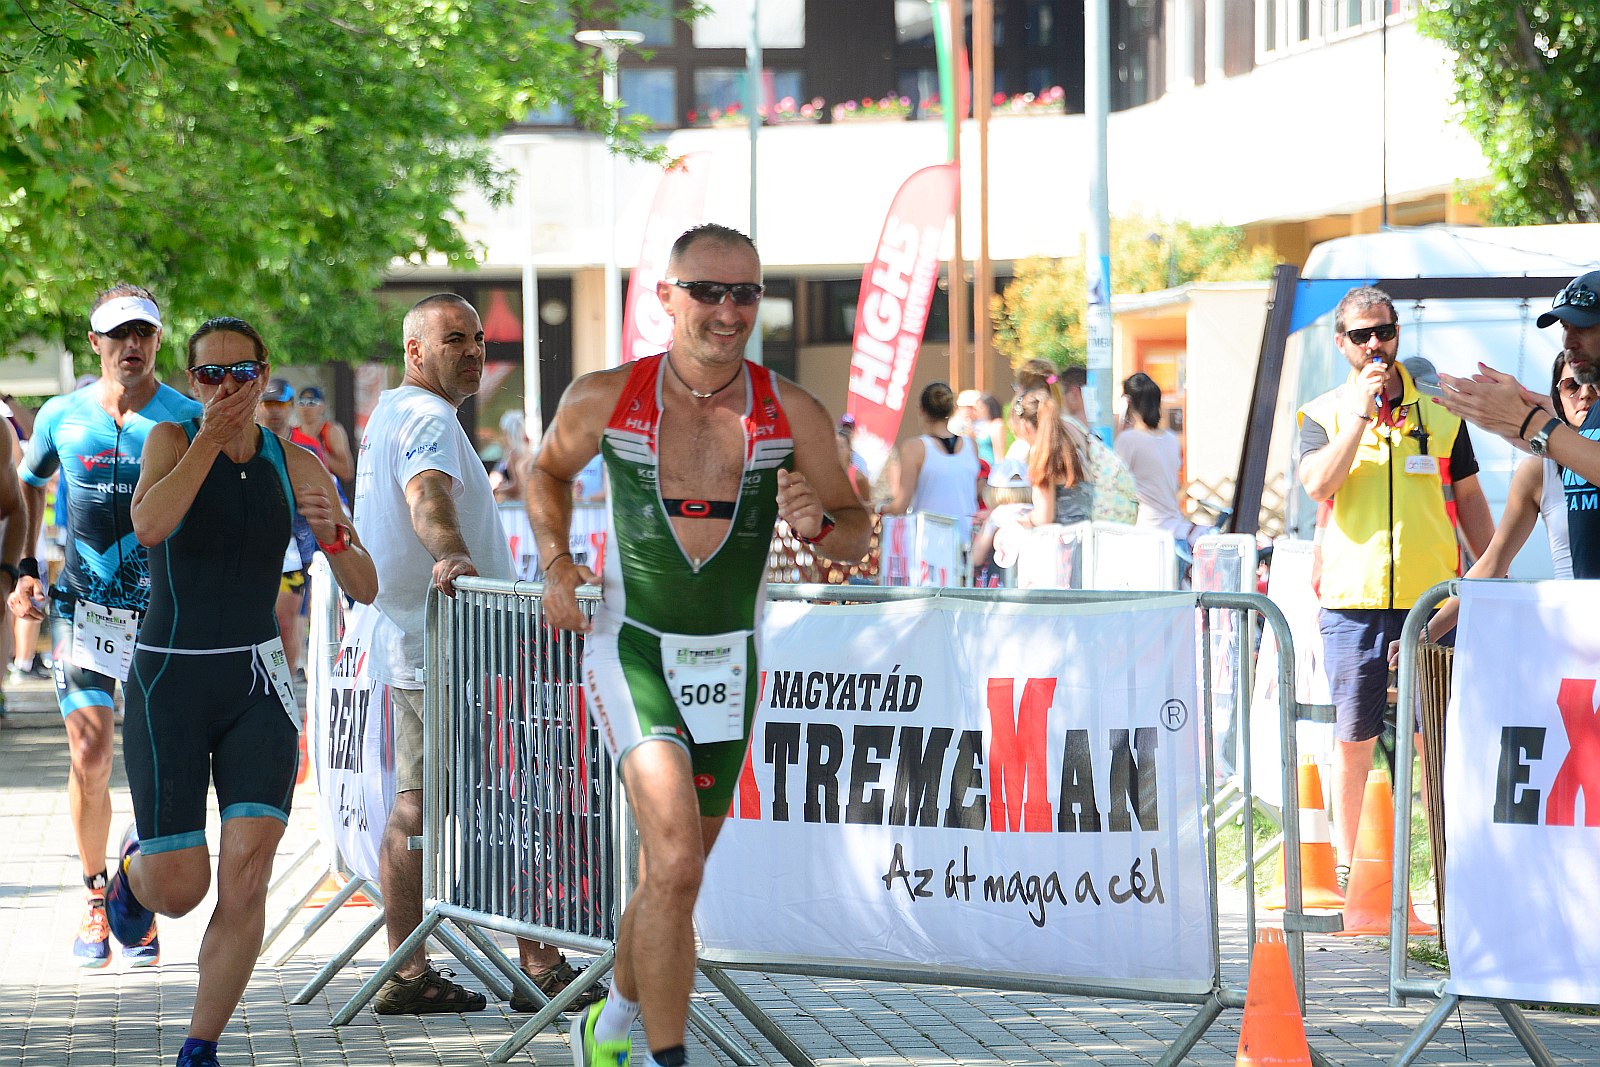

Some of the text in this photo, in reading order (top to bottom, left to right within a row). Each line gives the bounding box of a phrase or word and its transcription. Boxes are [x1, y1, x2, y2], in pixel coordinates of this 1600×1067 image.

[849, 216, 920, 405] HIGH5
[94, 635, 115, 654] 16
[681, 683, 726, 706] 508
[770, 664, 923, 713] NAGYATÁD
[882, 843, 1165, 928] Az út maga a cél
